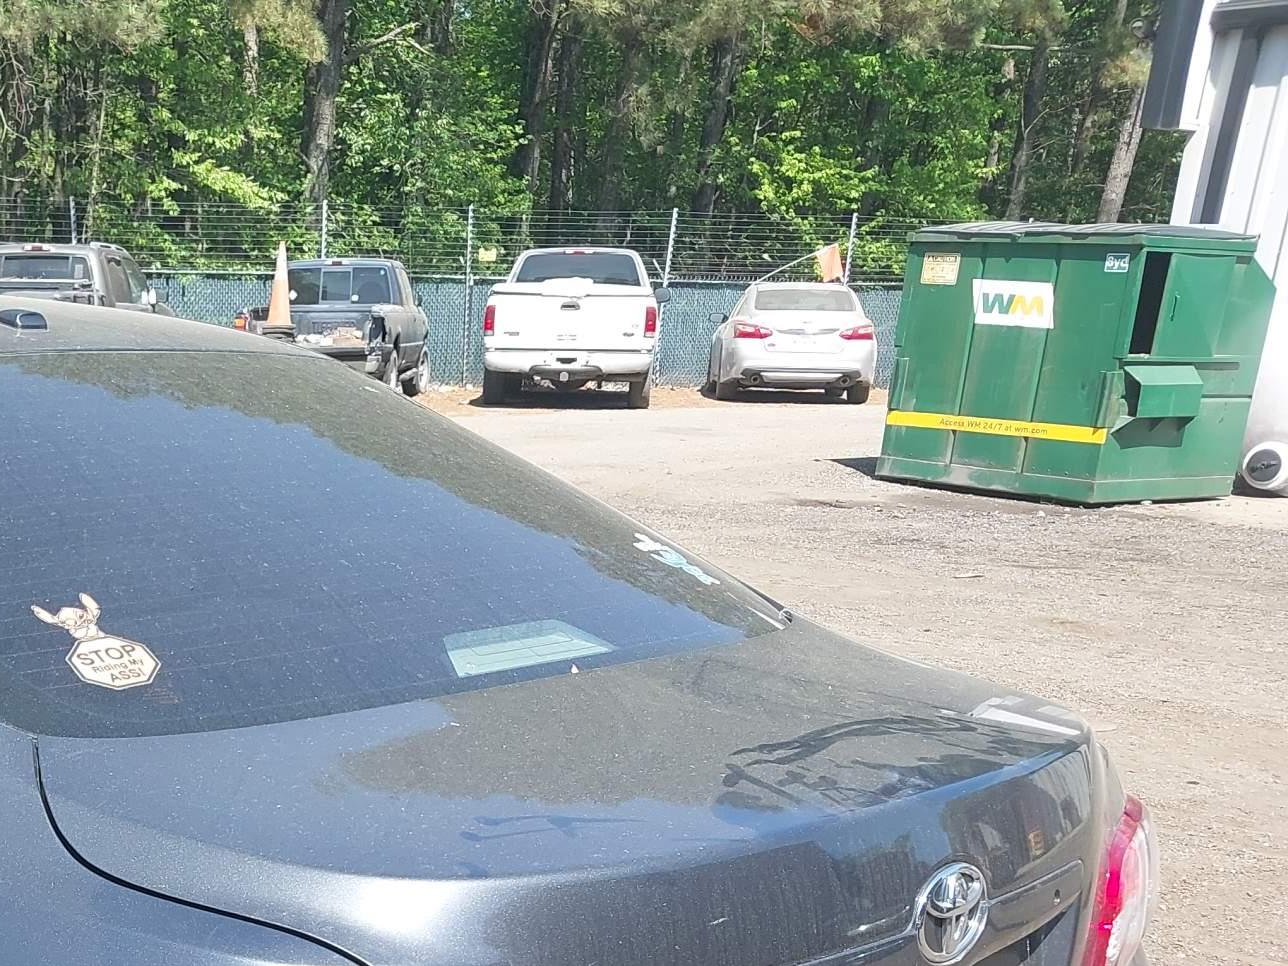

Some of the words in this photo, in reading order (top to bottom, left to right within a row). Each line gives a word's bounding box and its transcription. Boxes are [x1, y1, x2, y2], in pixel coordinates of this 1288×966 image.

[982, 292, 1044, 318] WM
[939, 418, 965, 427] Access
[967, 420, 982, 429] WM
[983, 422, 1003, 431] 24/7
[1004, 424, 1013, 432] at
[1014, 426, 1048, 435] wm.com
[76, 644, 136, 666] STOP
[91, 662, 129, 674] Riding
[127, 658, 145, 667] My
